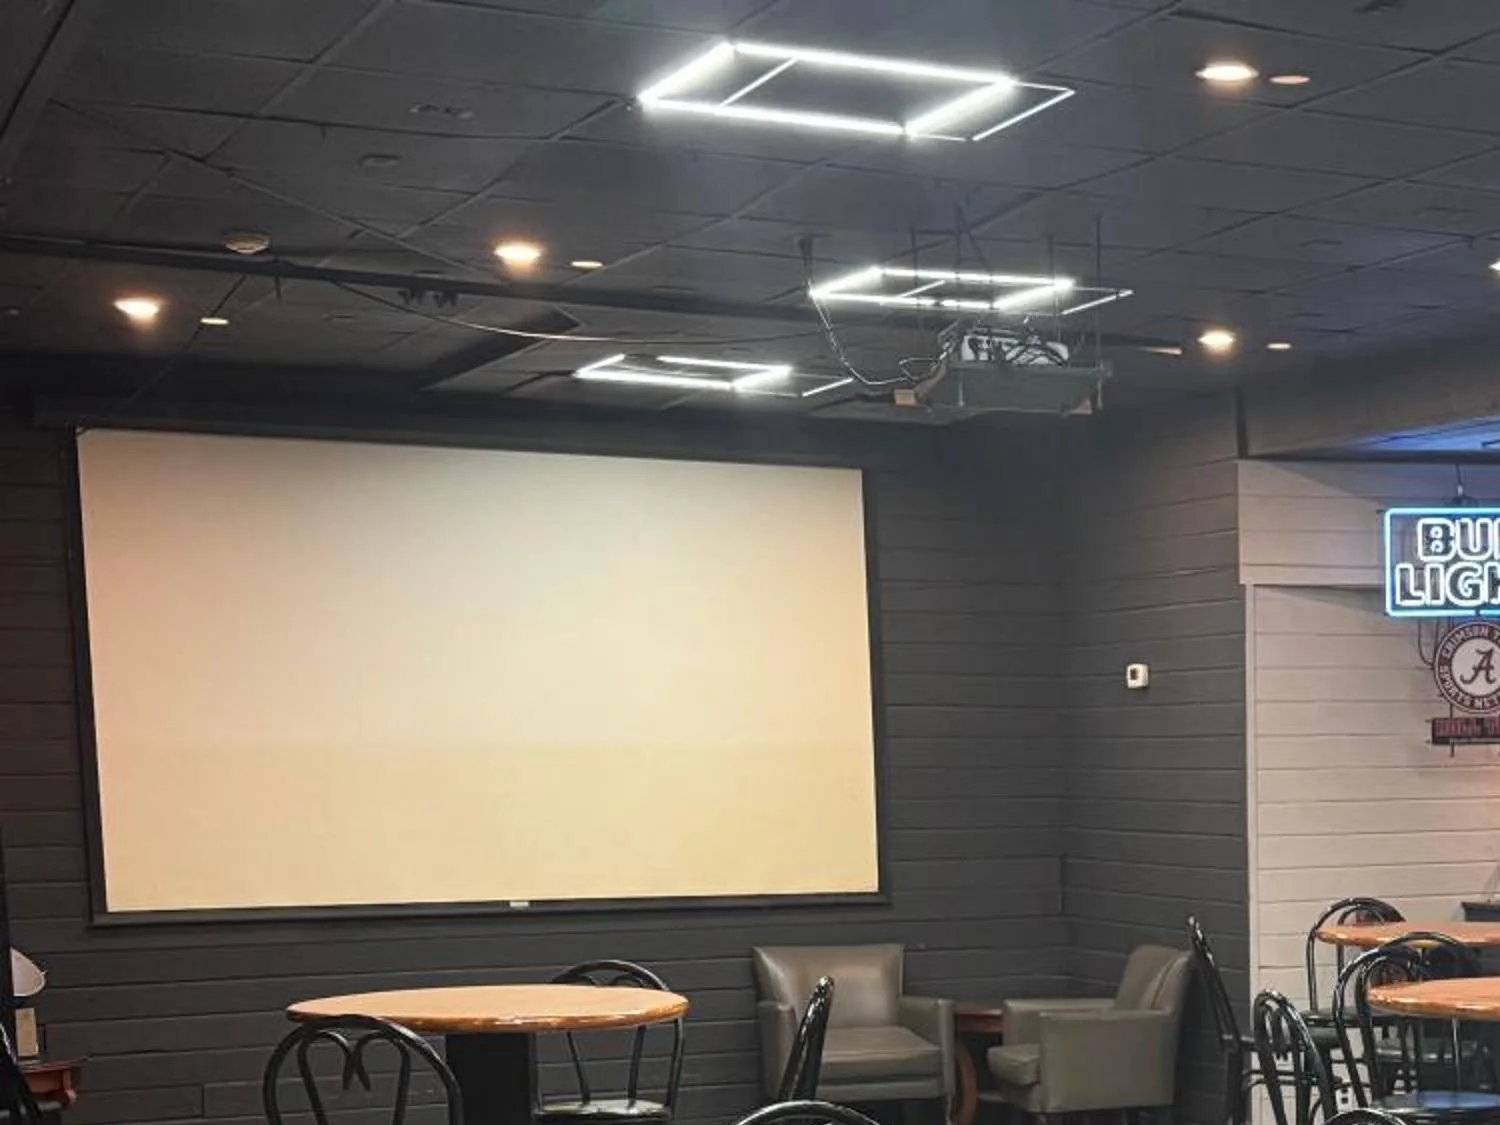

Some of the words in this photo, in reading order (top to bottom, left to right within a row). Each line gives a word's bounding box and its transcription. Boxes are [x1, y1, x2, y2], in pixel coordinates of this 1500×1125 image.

[1441, 626, 1489, 659] CRIMSON
[1460, 647, 1496, 684] A
[1440, 666, 1472, 708] SPORTS
